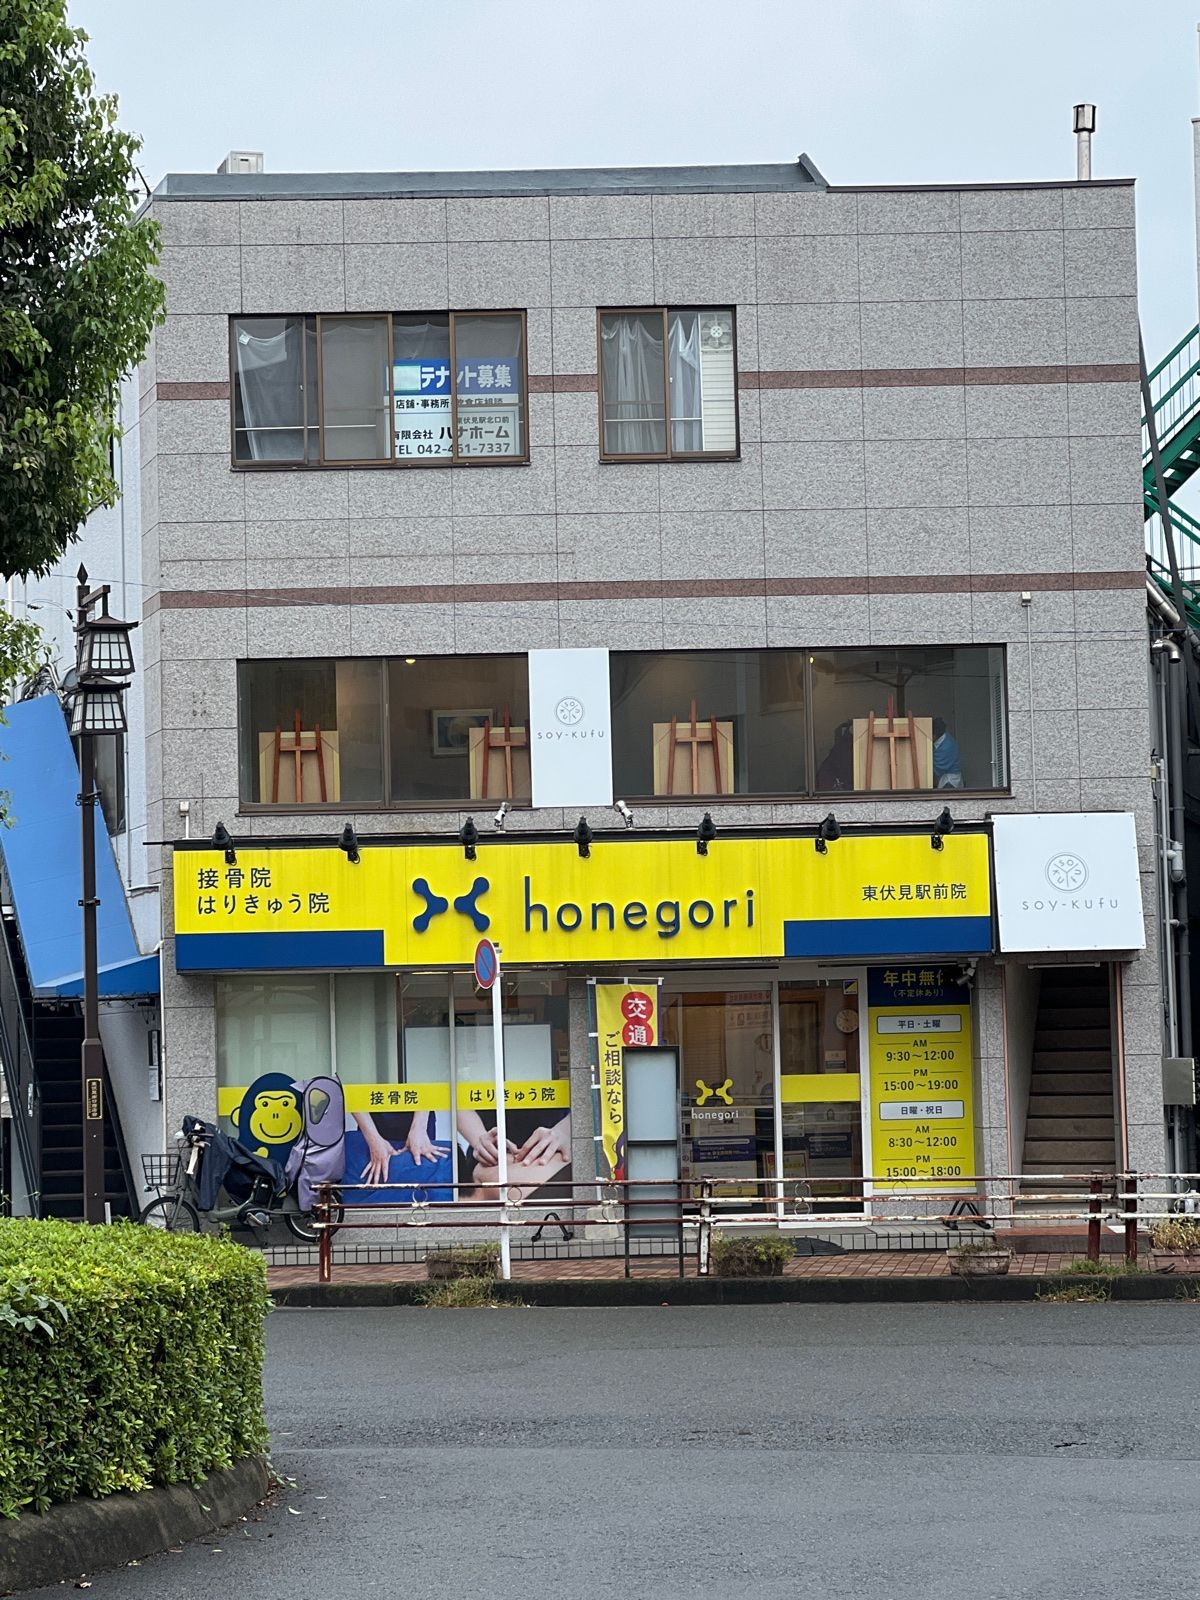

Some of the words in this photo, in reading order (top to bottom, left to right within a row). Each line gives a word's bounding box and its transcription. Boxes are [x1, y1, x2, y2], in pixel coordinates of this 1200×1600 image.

[197, 867, 272, 889] 接骨院
[862, 883, 967, 901] 東伏見駅前院
[197, 893, 330, 914] はりきゅう院
[524, 875, 754, 938] honegori
[897, 1019, 941, 1029] 平日・土曜
[604, 1030, 622, 1124] ご相談なら
[370, 1091, 418, 1105] 接骨院
[691, 1107, 739, 1120] honegori
[901, 1105, 943, 1115] 日曜・祝日
[915, 1155, 930, 1163] PM
